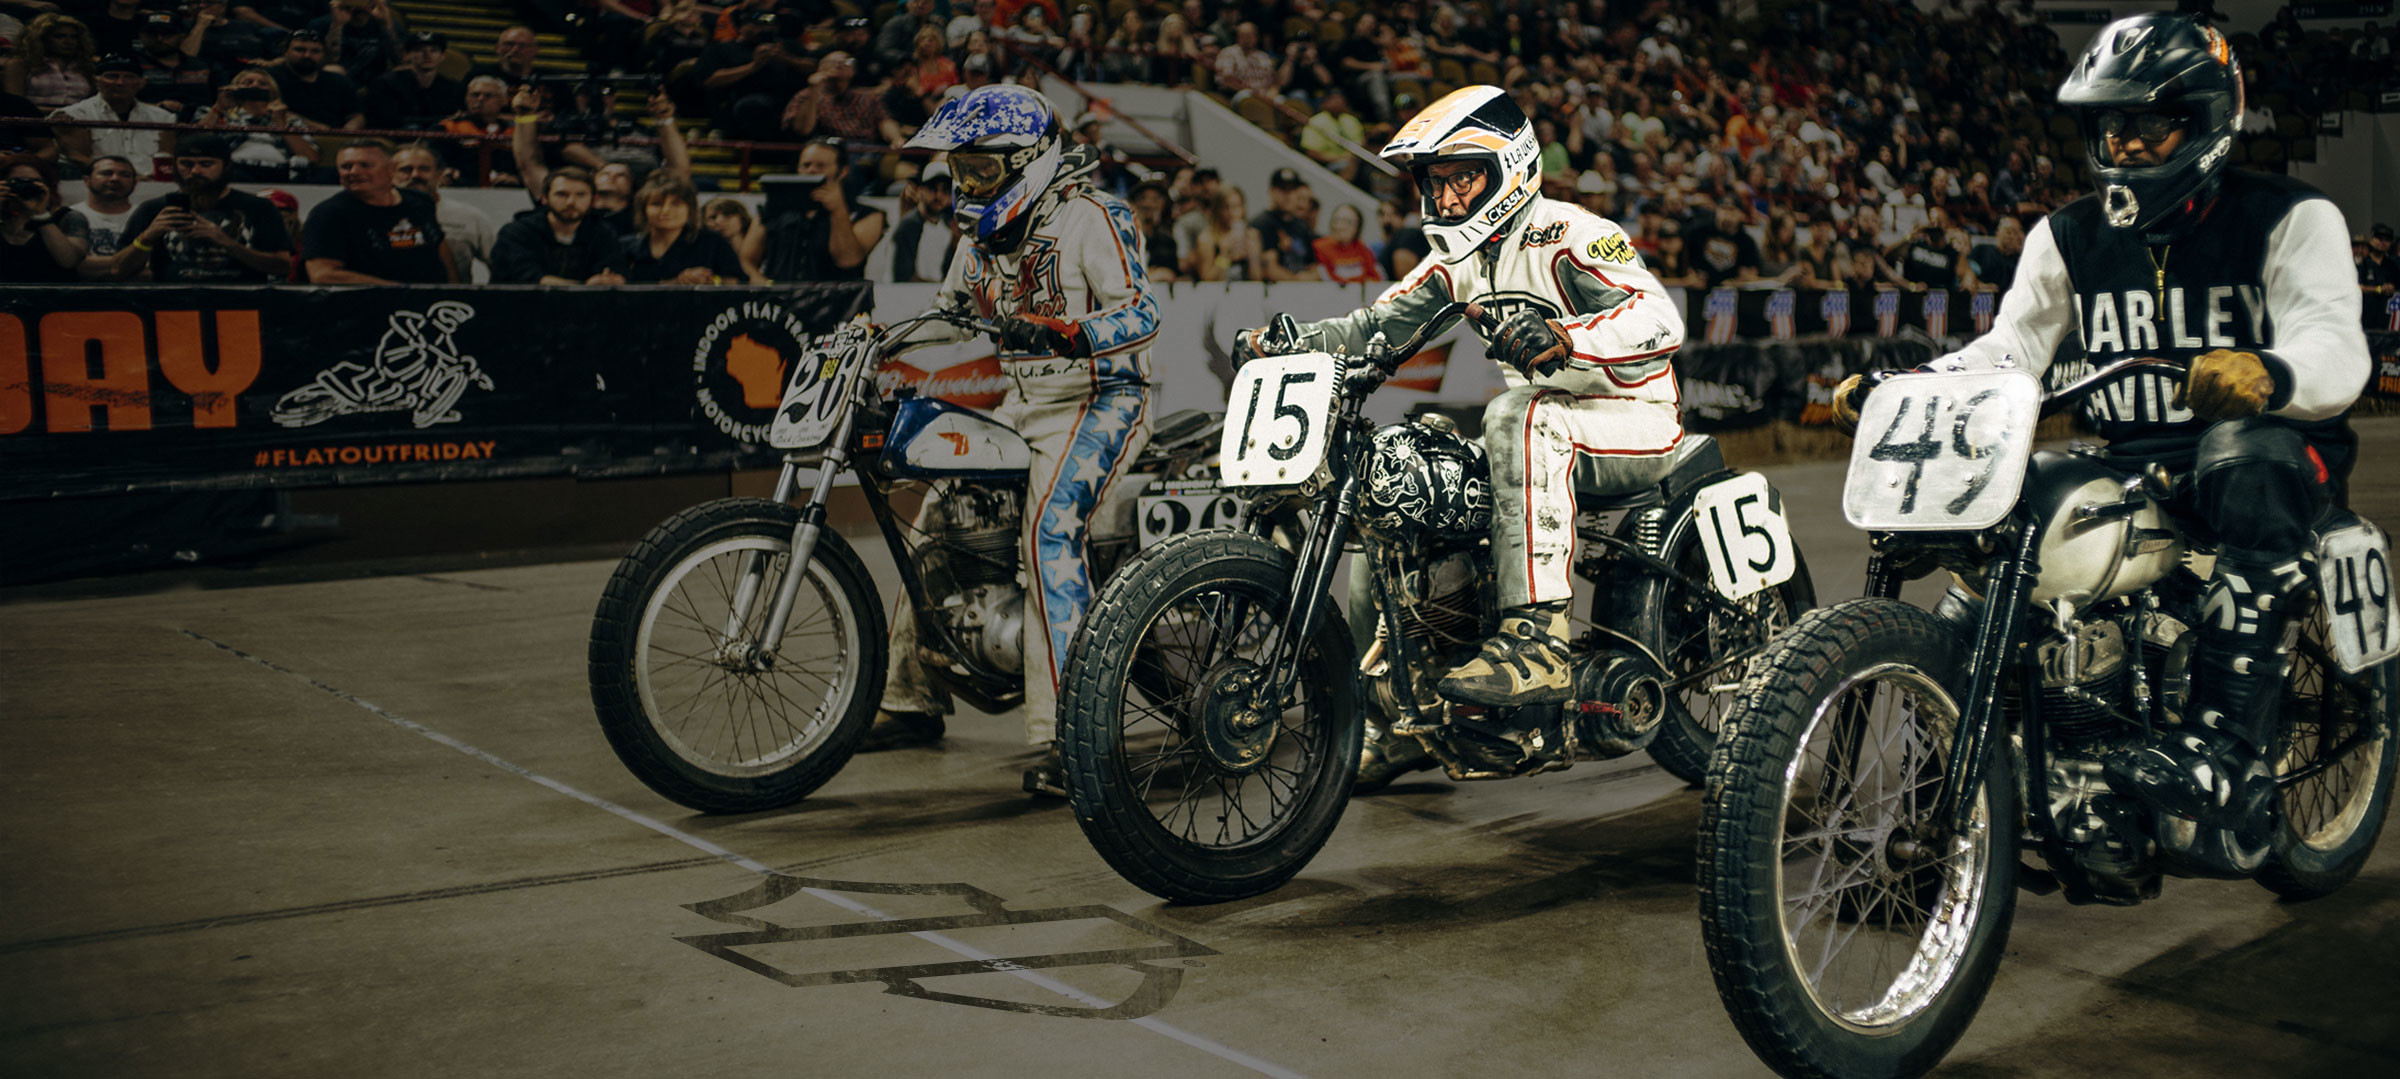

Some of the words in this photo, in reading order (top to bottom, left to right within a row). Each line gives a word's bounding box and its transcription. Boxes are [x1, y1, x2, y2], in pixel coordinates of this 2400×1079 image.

[1519, 221, 1569, 251] Scott
[0, 310, 262, 434] AY
[692, 306, 739, 373] INDOOR
[743, 301, 783, 323] FLAT
[1019, 358, 1090, 379] U.S.A.
[255, 440, 497, 467] #FLATOUTFRIDAY
[696, 386, 772, 443] MOTORCYC
[1236, 372, 1317, 461] 15
[1869, 388, 2010, 516] 49
[1709, 493, 1776, 584] 15
[2334, 548, 2390, 655] 49
